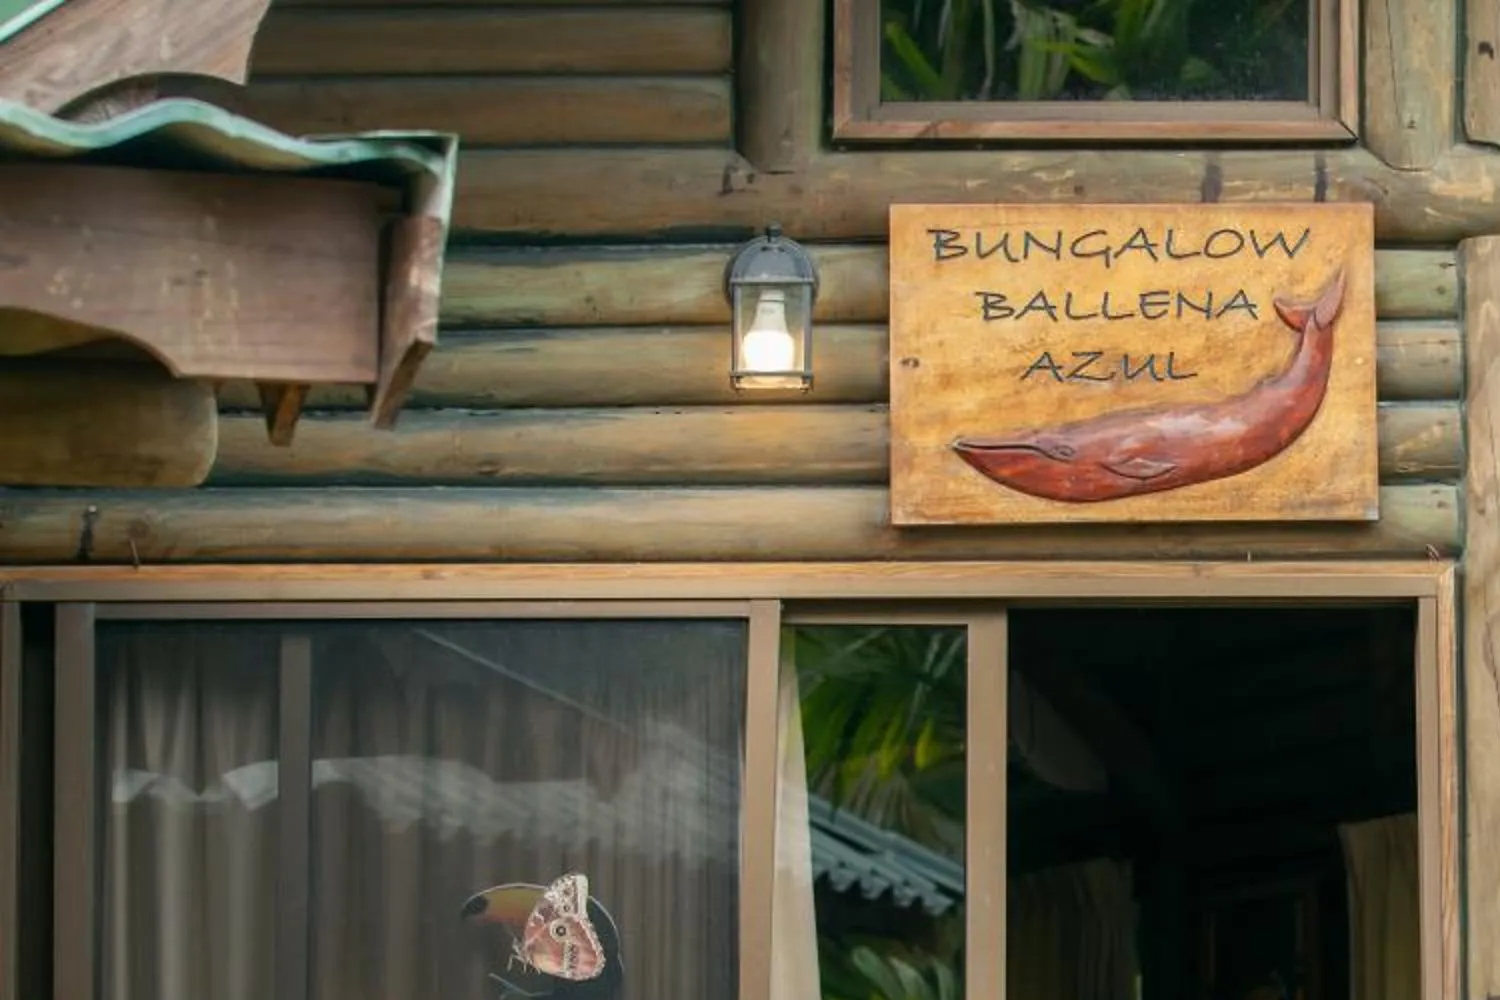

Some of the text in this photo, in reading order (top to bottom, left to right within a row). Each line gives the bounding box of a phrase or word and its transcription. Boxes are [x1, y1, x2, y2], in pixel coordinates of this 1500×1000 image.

[927, 227, 1311, 267] BUNGALOW
[975, 289, 1259, 321] BALLENA
[1020, 351, 1199, 382] AZUL
